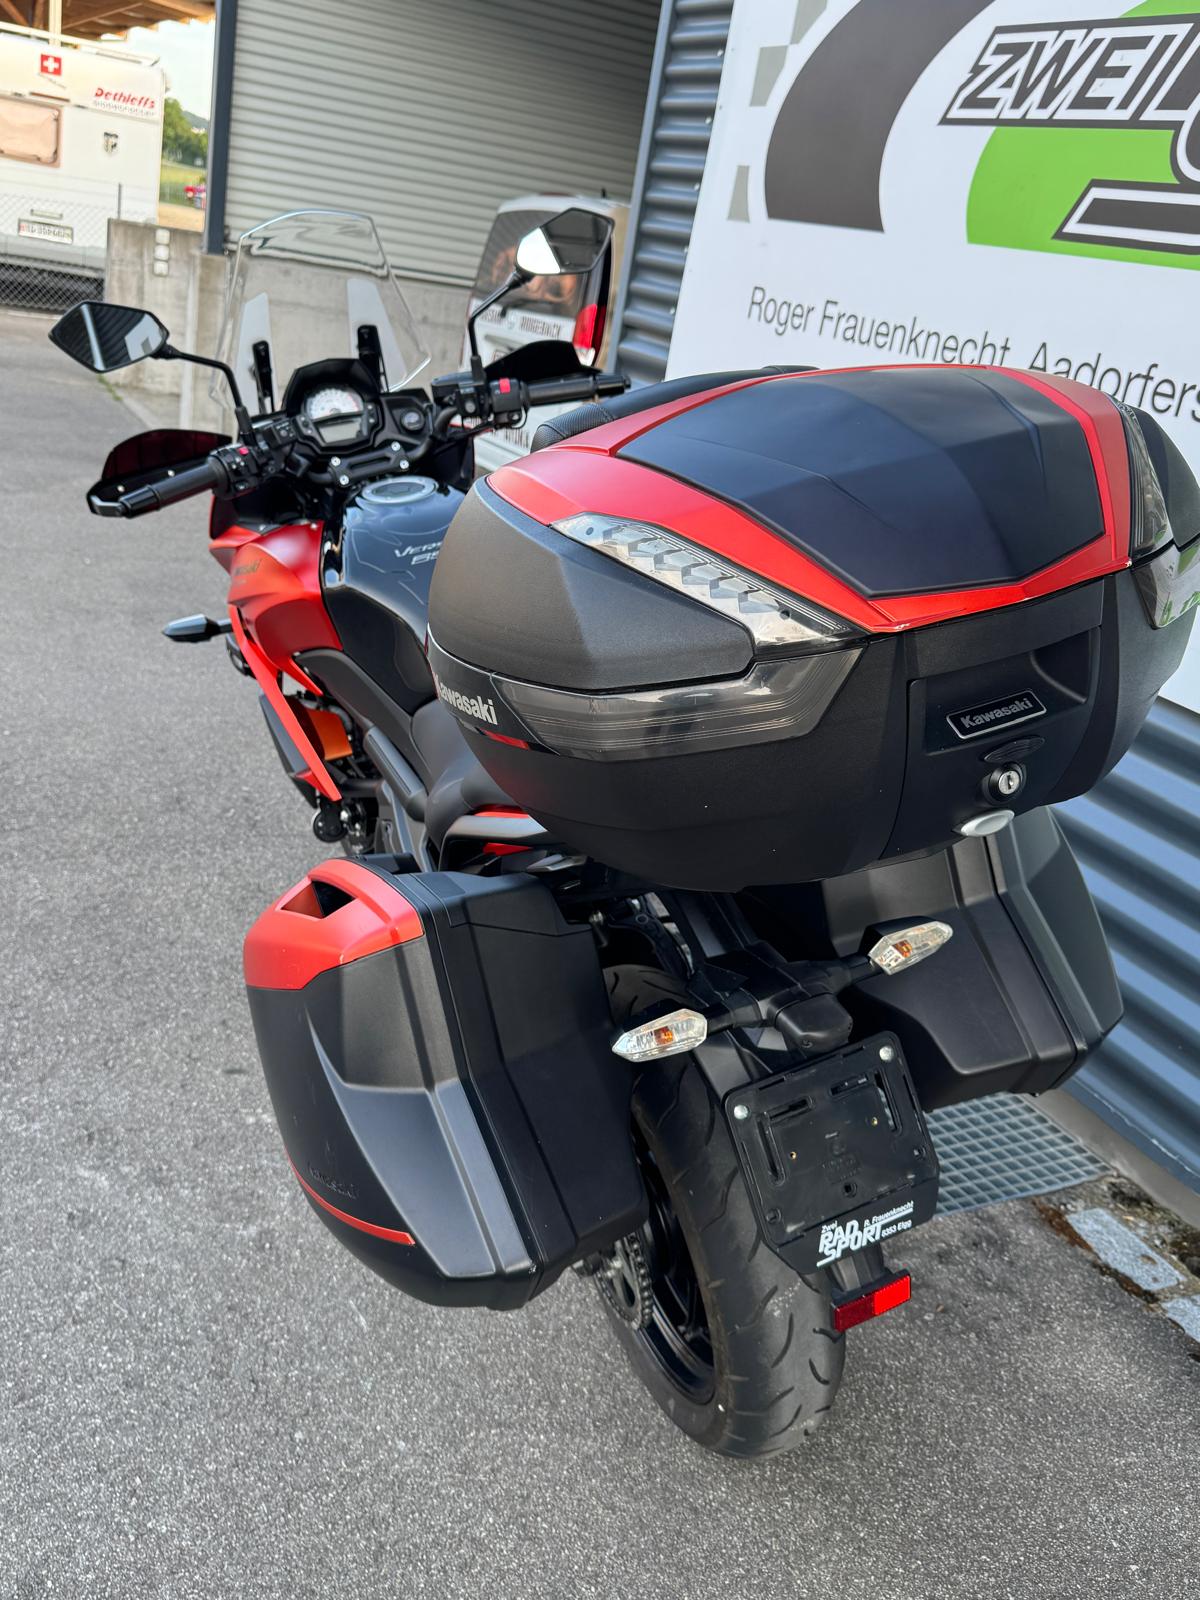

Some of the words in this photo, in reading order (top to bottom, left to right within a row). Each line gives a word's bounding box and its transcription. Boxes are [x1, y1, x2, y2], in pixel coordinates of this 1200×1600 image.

[748, 286, 814, 336] Roger
[819, 299, 1010, 366] Frauenknecht
[960, 697, 1033, 728] Kawasaki
[818, 1219, 861, 1253] RAD
[820, 1223, 881, 1262] SPORT
